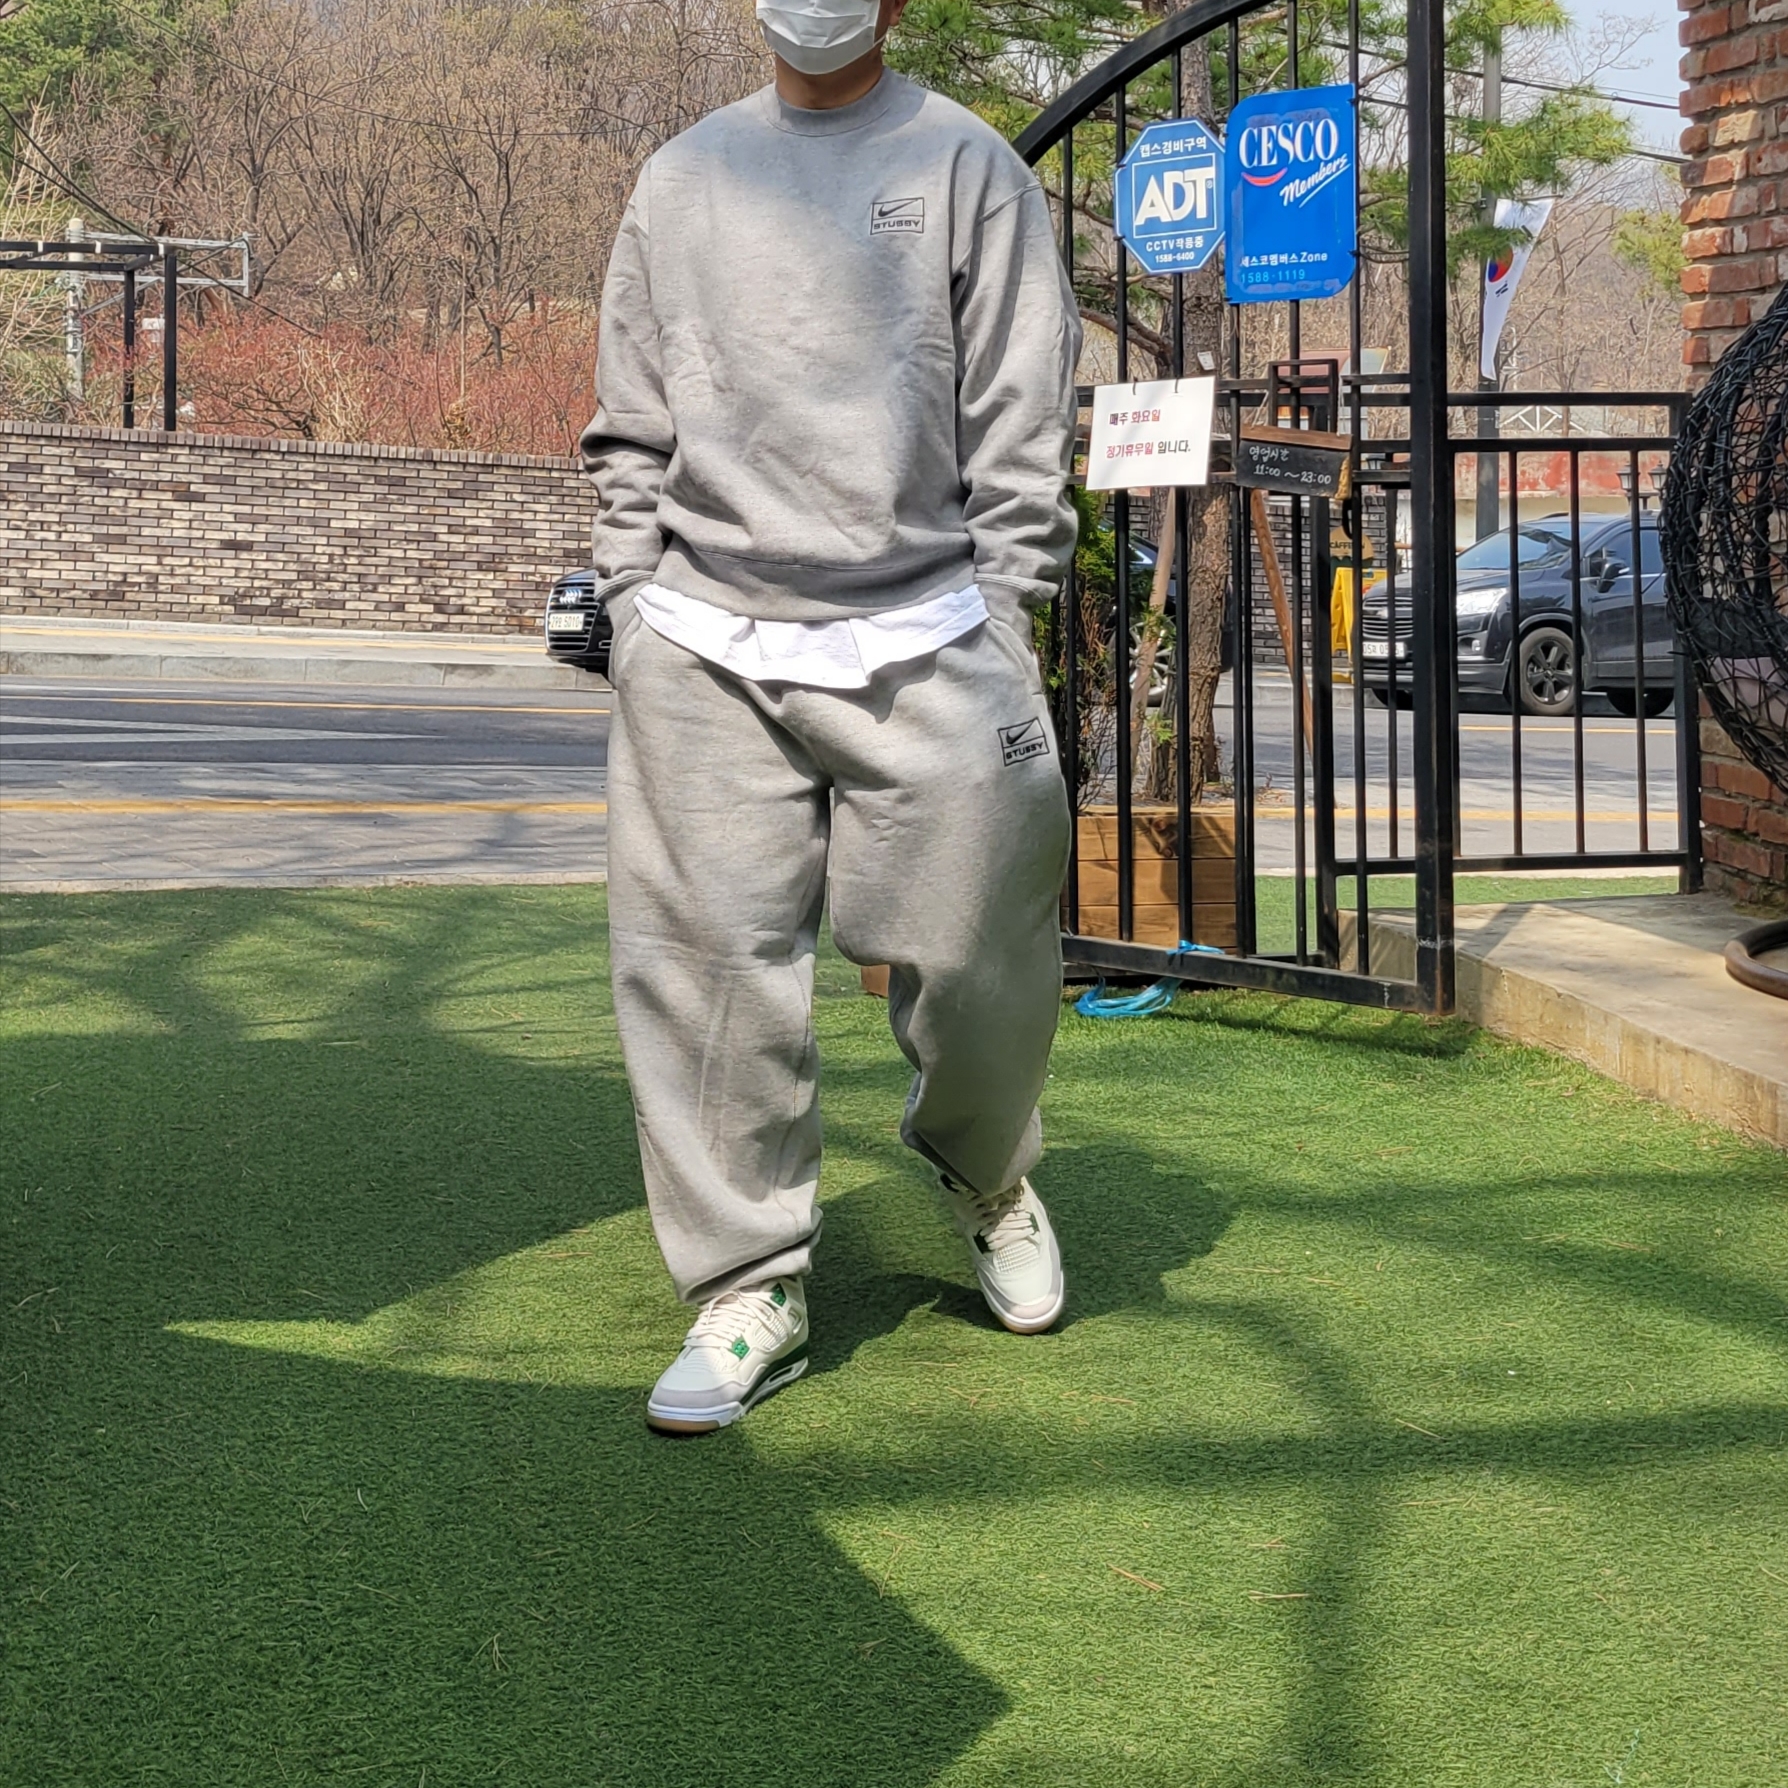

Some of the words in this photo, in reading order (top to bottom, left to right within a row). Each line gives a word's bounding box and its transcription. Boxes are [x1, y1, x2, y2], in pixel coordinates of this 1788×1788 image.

[1239, 119, 1338, 169] CESCO
[1134, 167, 1215, 226] ADT
[1279, 153, 1348, 207] Members
[1109, 412, 1129, 426] 매주
[1130, 409, 1161, 424] 화요일
[1106, 441, 1154, 459] 정기휴무일
[1249, 445, 1290, 463] 영업시간
